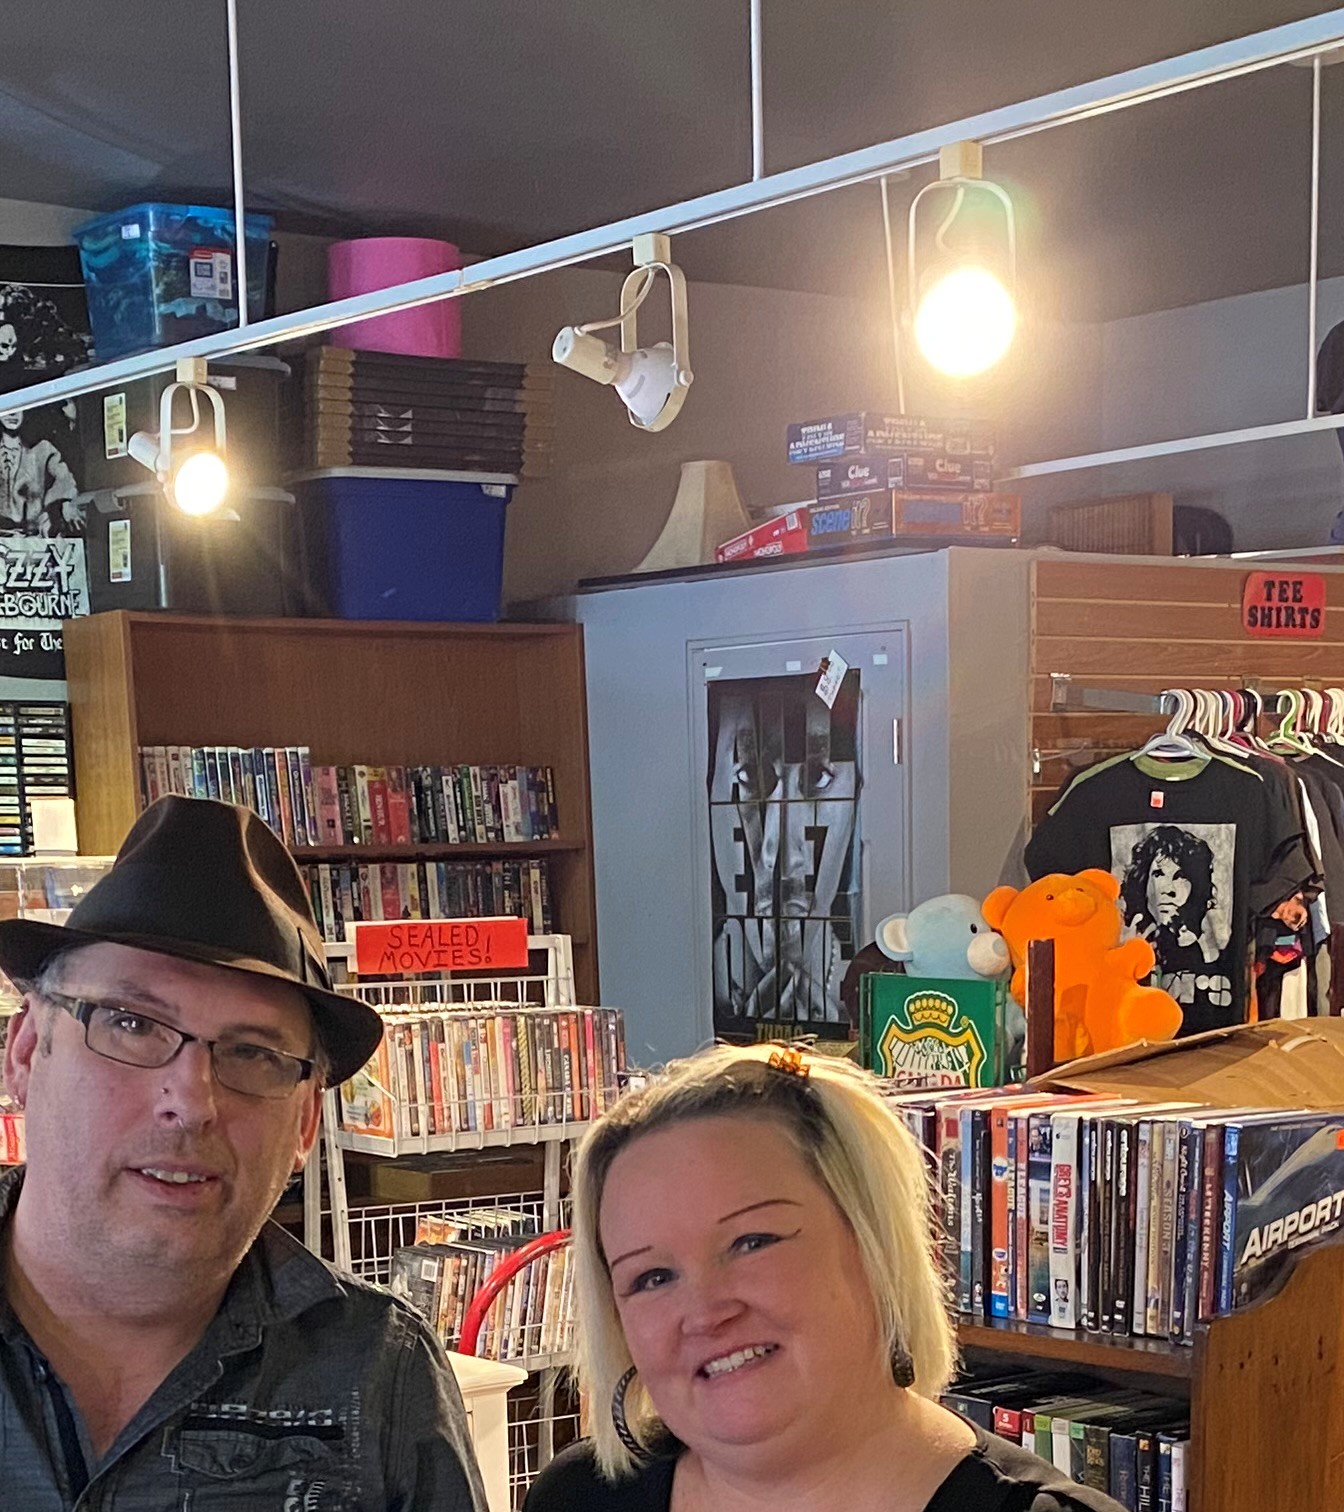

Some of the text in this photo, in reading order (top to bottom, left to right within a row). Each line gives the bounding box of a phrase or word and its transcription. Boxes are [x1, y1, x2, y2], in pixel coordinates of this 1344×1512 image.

[847, 465, 870, 479] Clue
[811, 509, 850, 536] scene
[1263, 580, 1304, 603] TEE
[1247, 603, 1321, 630] SHIRTS
[379, 931, 493, 970] MOVIES!
[386, 923, 481, 951] SEALED
[1052, 1163, 1072, 1248] GREY'S ANATOMY
[1221, 1189, 1235, 1251] AIRPORT
